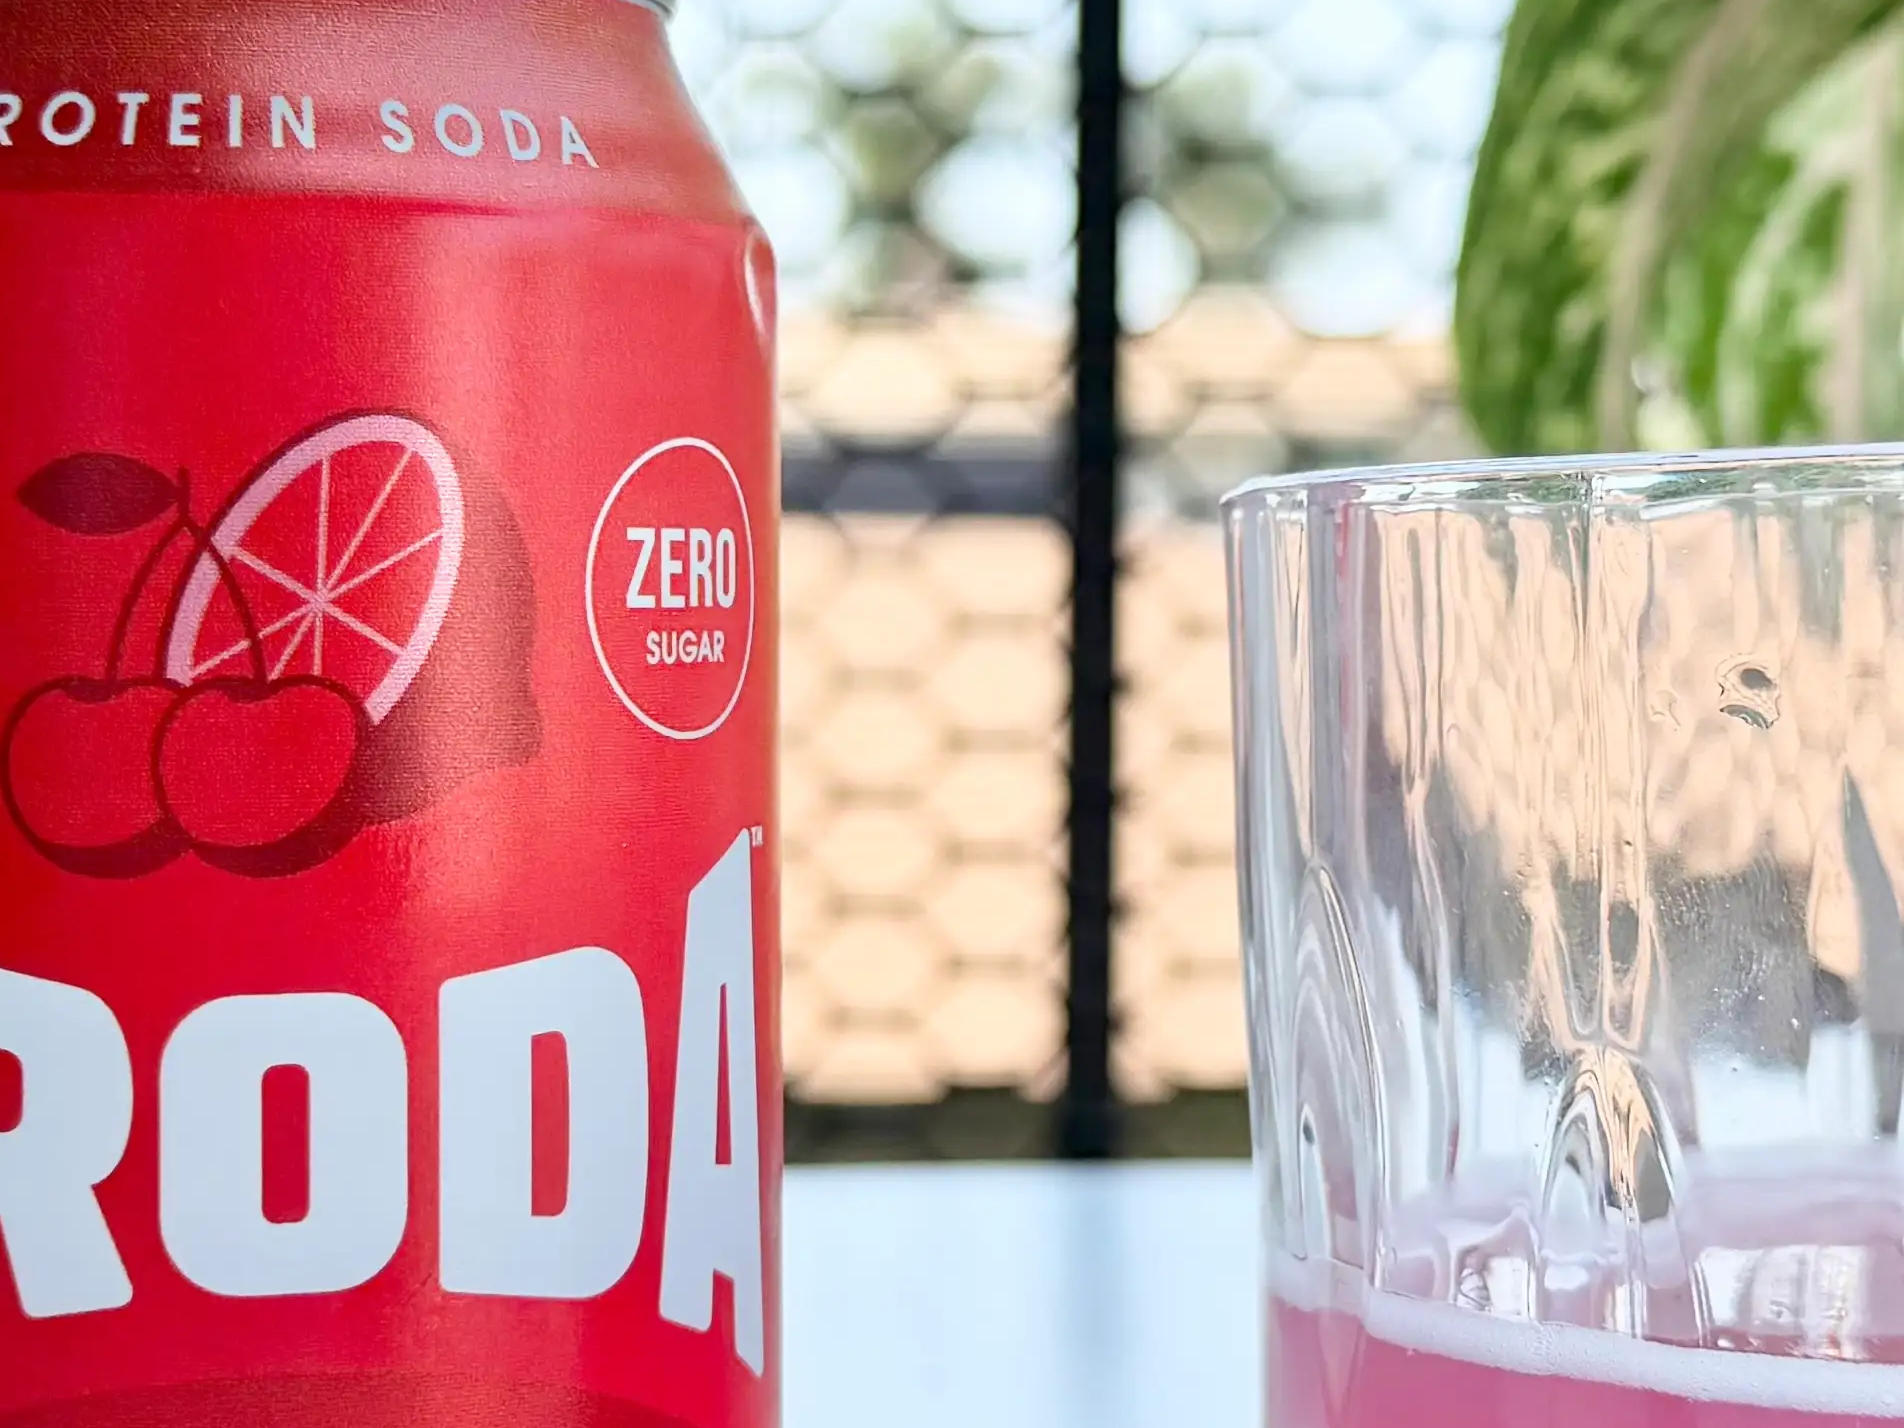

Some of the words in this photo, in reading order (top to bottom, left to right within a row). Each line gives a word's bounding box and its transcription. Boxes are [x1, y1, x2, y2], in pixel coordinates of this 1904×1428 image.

[380, 99, 601, 169] SODA
[625, 526, 737, 610] ZERO
[645, 629, 726, 666] SUGAR
